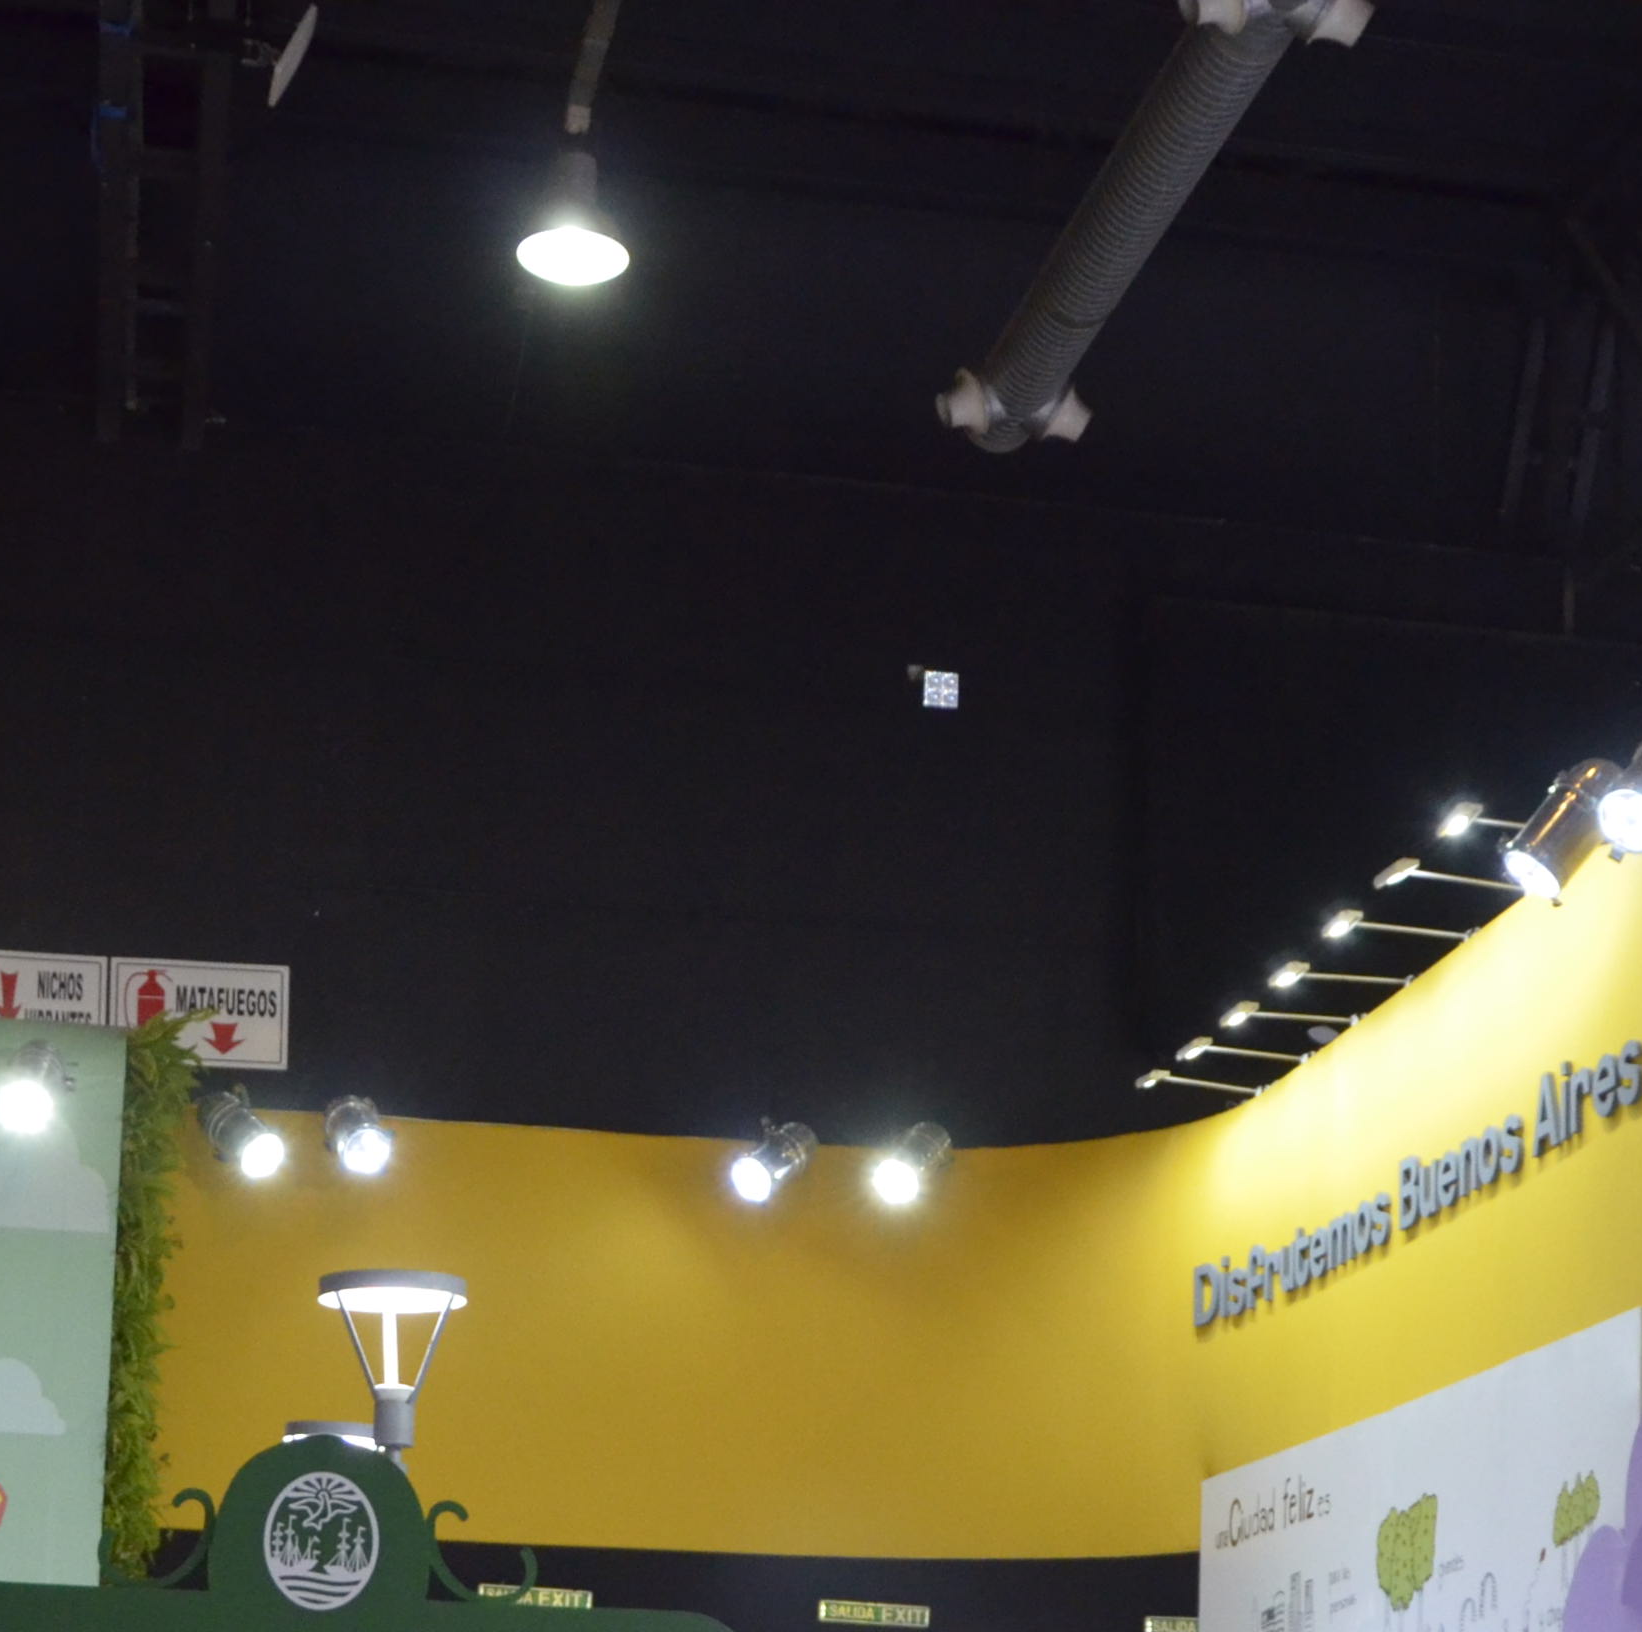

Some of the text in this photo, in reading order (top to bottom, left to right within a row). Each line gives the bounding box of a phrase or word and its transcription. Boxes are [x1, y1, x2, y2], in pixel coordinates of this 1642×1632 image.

[37, 971, 83, 1001] NICHOS
[173, 982, 280, 1020] MATAFUEGOS
[1192, 1192, 1391, 1328] Disfrutemos
[1398, 1114, 1523, 1231] Buenos
[1283, 1473, 1314, 1530] feliz
[538, 1591, 583, 1607] EXIT
[829, 1603, 925, 1625] SALIDA EXIT
